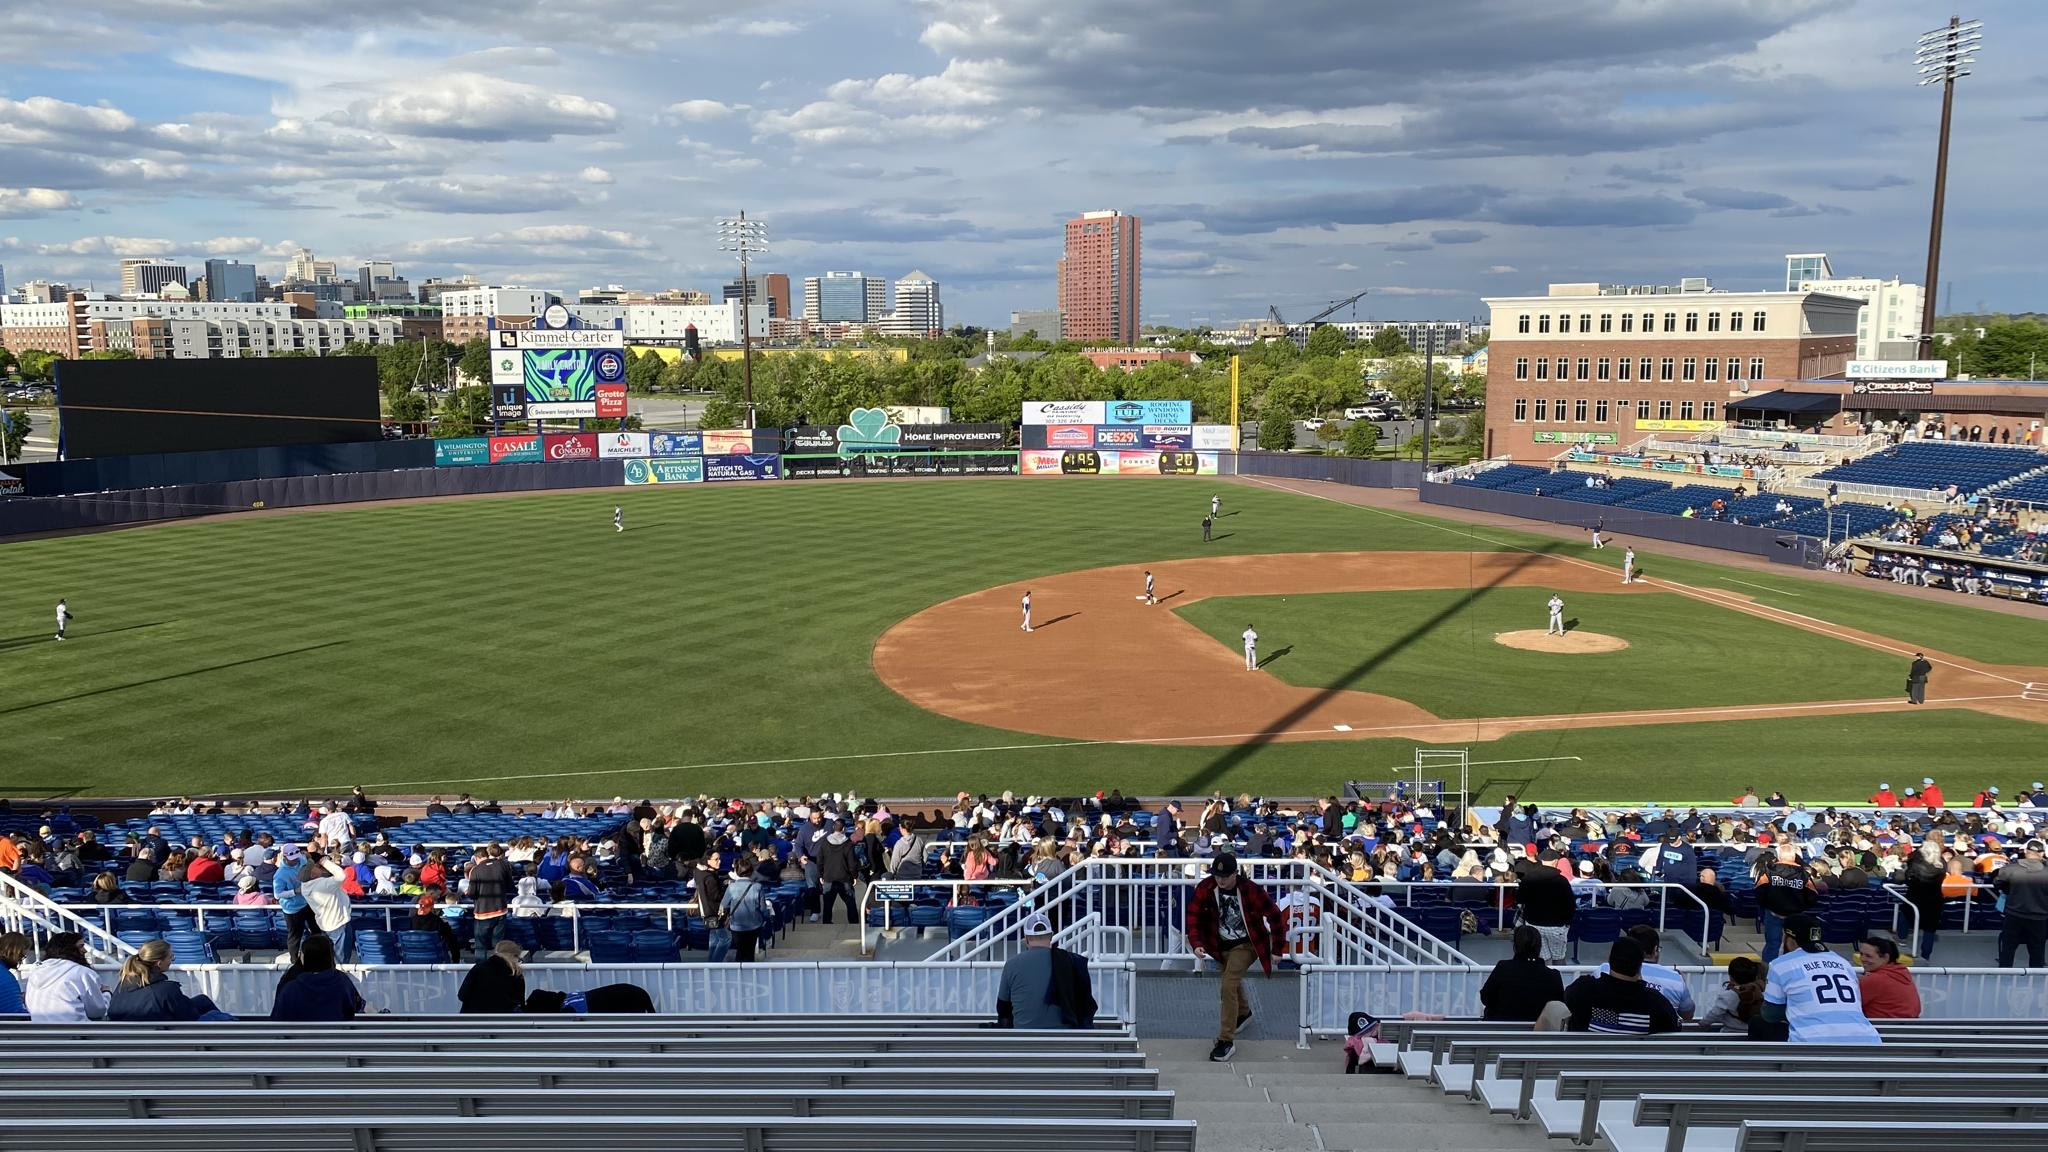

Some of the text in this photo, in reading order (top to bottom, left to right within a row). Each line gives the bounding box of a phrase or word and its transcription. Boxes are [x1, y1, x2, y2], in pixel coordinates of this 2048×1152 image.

[521, 331, 613, 343] Kimmel Carter
[1863, 364, 1937, 374] Citizens Bank
[597, 390, 625, 399] Grotto
[601, 398, 622, 406] Pizza
[496, 404, 523, 412] unique
[1040, 403, 1086, 413] Cassidy
[499, 410, 521, 418] image
[905, 432, 1001, 441] HOME IMPROVEMENTS
[1098, 432, 1134, 443] DE529
[444, 442, 487, 450] WILMINGTON
[493, 441, 538, 453] CASALE
[551, 443, 591, 460] CONCORD
[1039, 456, 1058, 465] MEGA
[664, 473, 688, 481] BANK
[1803, 960, 1845, 971] BLUE ROCKS
[1812, 974, 1855, 1004] 26
